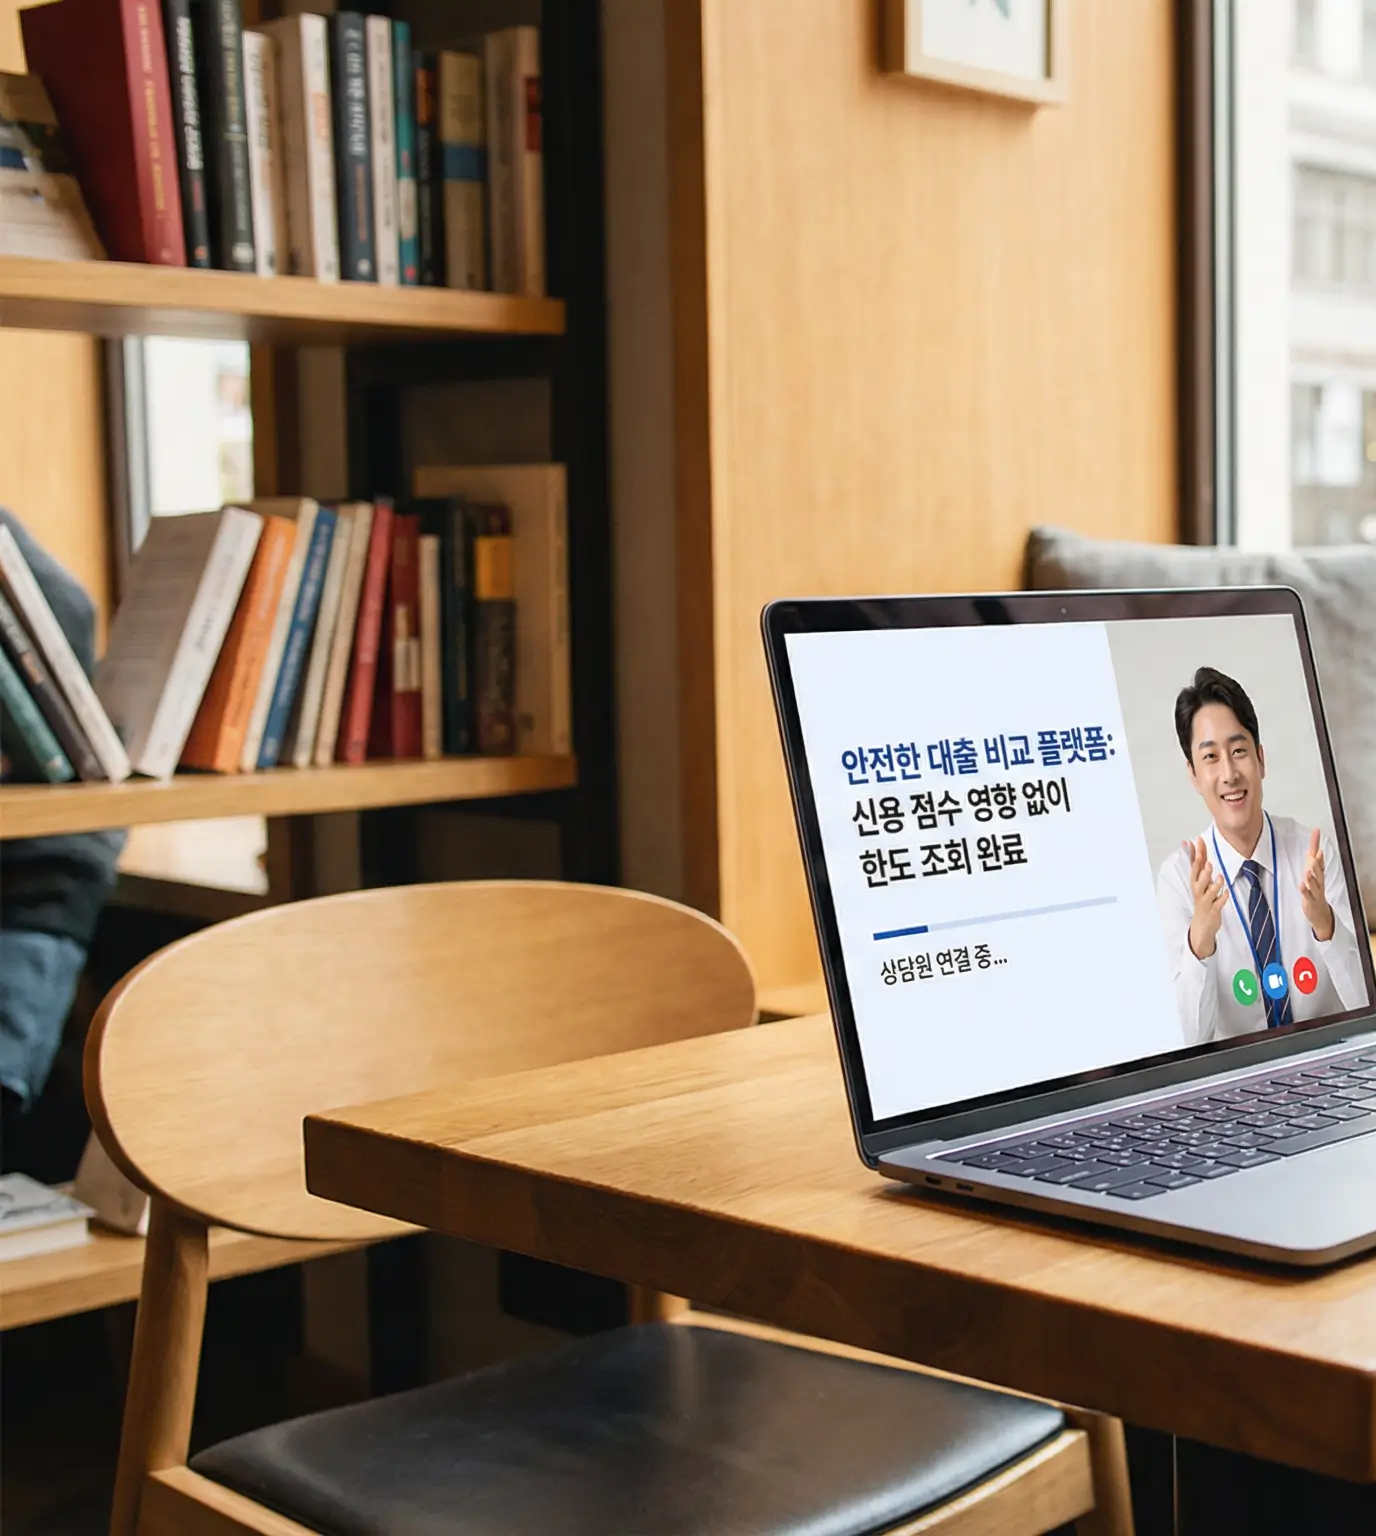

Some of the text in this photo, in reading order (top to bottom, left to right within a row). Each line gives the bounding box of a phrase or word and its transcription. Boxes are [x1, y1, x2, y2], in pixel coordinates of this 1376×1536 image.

[841, 726, 1117, 785] 안전한 대출 비교 플랫폼:
[852, 776, 1071, 838] 신용 점수 영향 없이
[859, 832, 1028, 888] 한도 조회 완료
[880, 943, 1008, 986] 상담원 연결 중...
